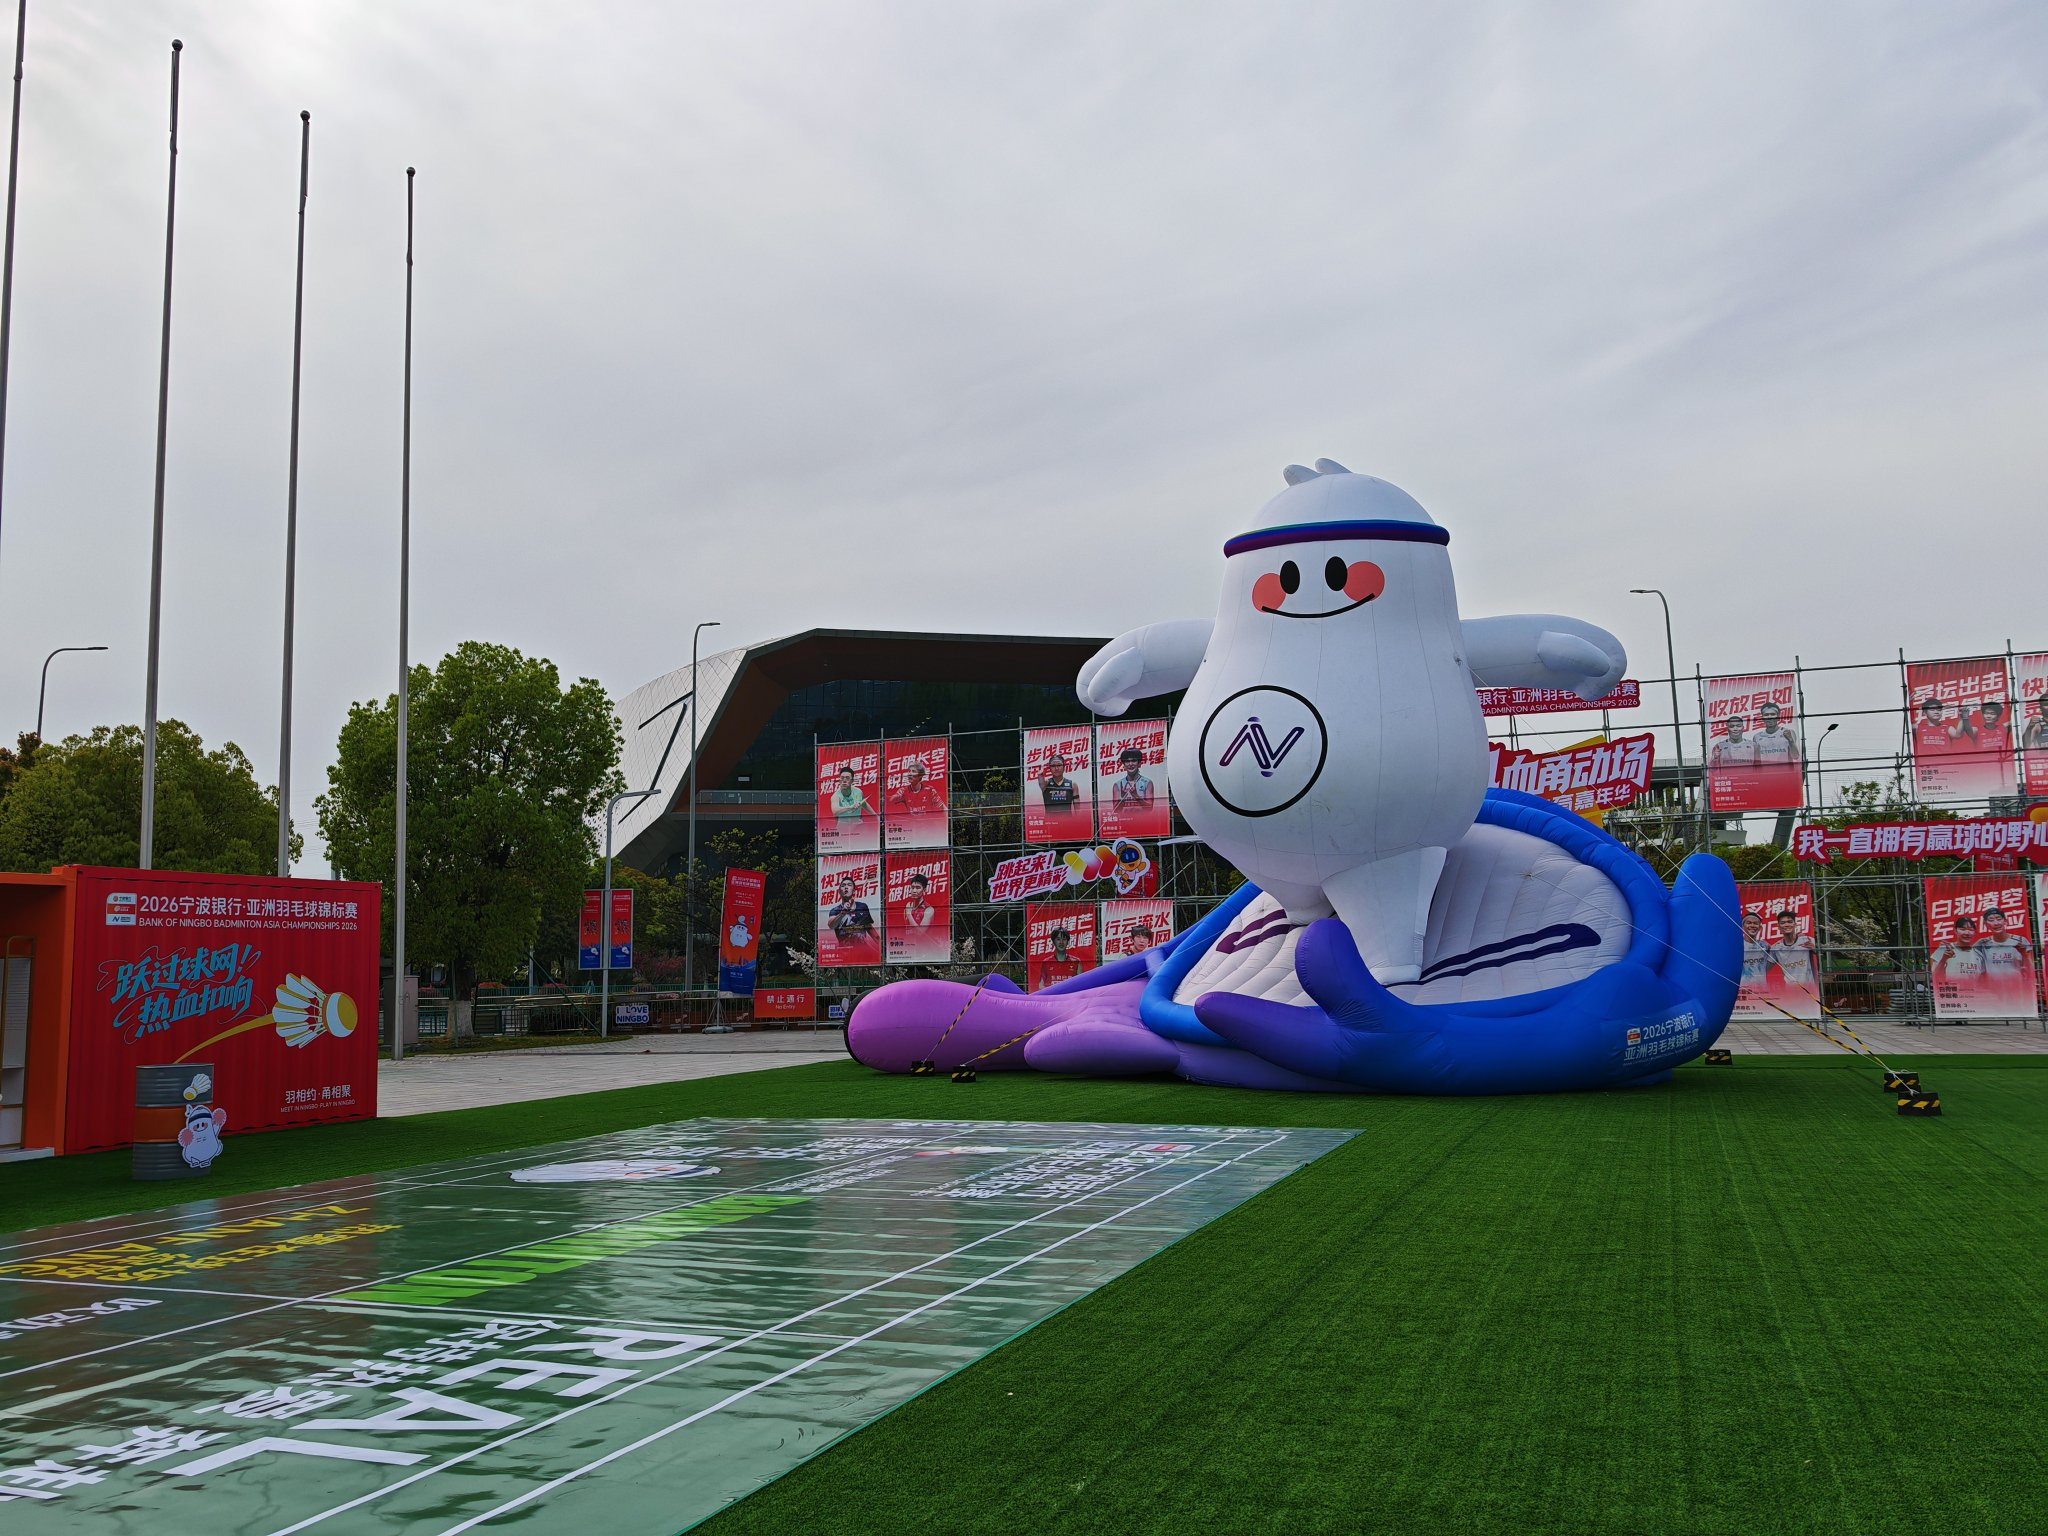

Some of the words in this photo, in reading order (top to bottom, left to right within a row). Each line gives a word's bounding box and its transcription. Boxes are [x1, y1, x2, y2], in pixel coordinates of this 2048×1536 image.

[1529, 704, 1548, 712] ASIA
[1549, 700, 1617, 711] CHAMPIONSHIPS
[1618, 698, 1638, 706] 2026
[1708, 685, 1793, 718] 收放自如
[992, 852, 1054, 882] 跳起来!
[990, 866, 1070, 900] 世界更精彩
[139, 895, 358, 919] 2026宁波银行·亚洲羽毛球锦标赛
[1931, 887, 2023, 920] 白羽凌空
[138, 917, 164, 928] BANK
[165, 918, 178, 928] OF
[179, 918, 212, 929] NINGBO
[213, 919, 262, 930] BADMINTON
[263, 920, 281, 930] ASIA
[282, 920, 340, 931] CHAMPIONSHIPS
[341, 922, 358, 931] 2026
[1104, 911, 1170, 938] 行云流水
[626, 1006, 648, 1014] LOVE
[766, 994, 805, 1004] 禁止通行
[616, 1015, 648, 1023] NINGBO
[1642, 1012, 1696, 1040] 2026宁波银行
[1623, 1027, 1700, 1061] 亚洲羽毛球锦标赛
[280, 1105, 293, 1113] MEET
[162, 1328, 724, 1476] REAL
